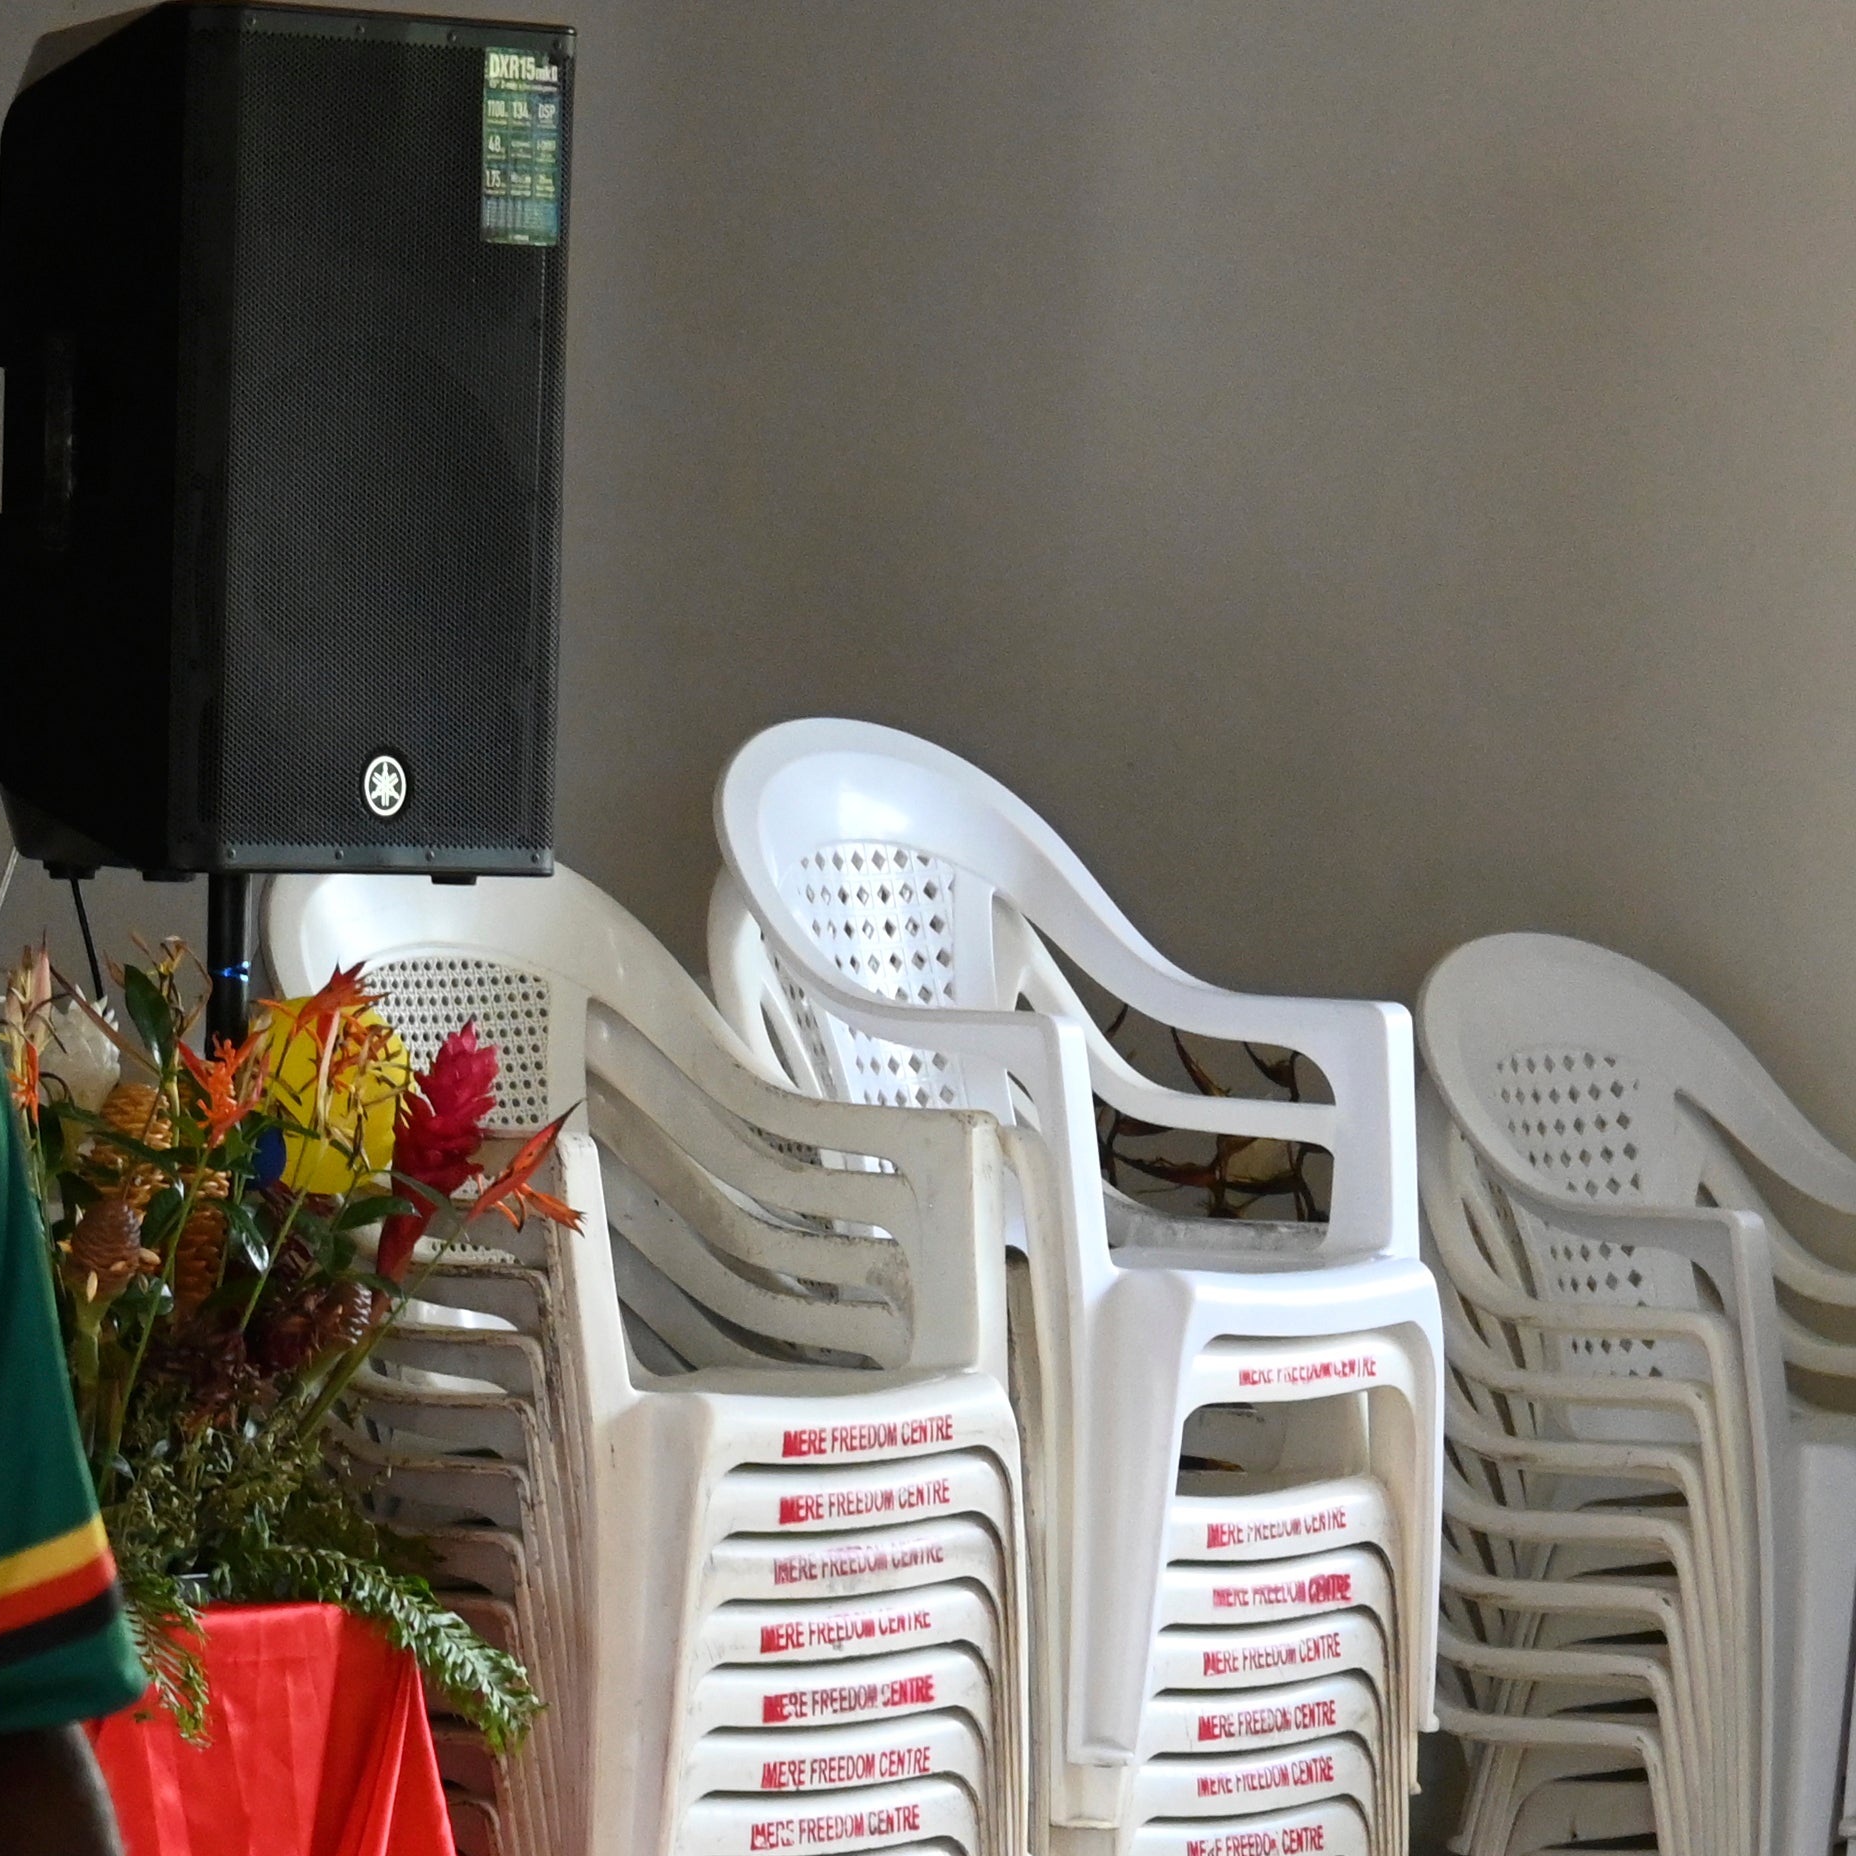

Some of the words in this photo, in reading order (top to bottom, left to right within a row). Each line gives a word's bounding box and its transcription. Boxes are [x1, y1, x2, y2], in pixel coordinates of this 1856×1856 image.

[488, 53, 535, 81] DXR15
[831, 1423, 898, 1453] FREEDOM
[901, 1414, 953, 1446] CENTRE
[828, 1489, 895, 1518] FREEDOM
[898, 1478, 950, 1509] CENTRE
[809, 1615, 876, 1646] FREEDOM
[1242, 1645, 1297, 1671] FREEDOM
[1299, 1632, 1341, 1662] CENTRE
[811, 1684, 878, 1716] FREEDOM
[881, 1675, 935, 1708] CENTRE
[1238, 1707, 1291, 1737] FREEDOM
[1294, 1700, 1336, 1730] CENTRE
[810, 1753, 875, 1784] FREEDOM
[879, 1746, 931, 1777] CENTRE
[1291, 1756, 1334, 1786] CENTRE
[798, 1812, 865, 1844] FREEDOM
[868, 1804, 920, 1835] CENTRE
[1282, 1825, 1324, 1855] CENTRE
